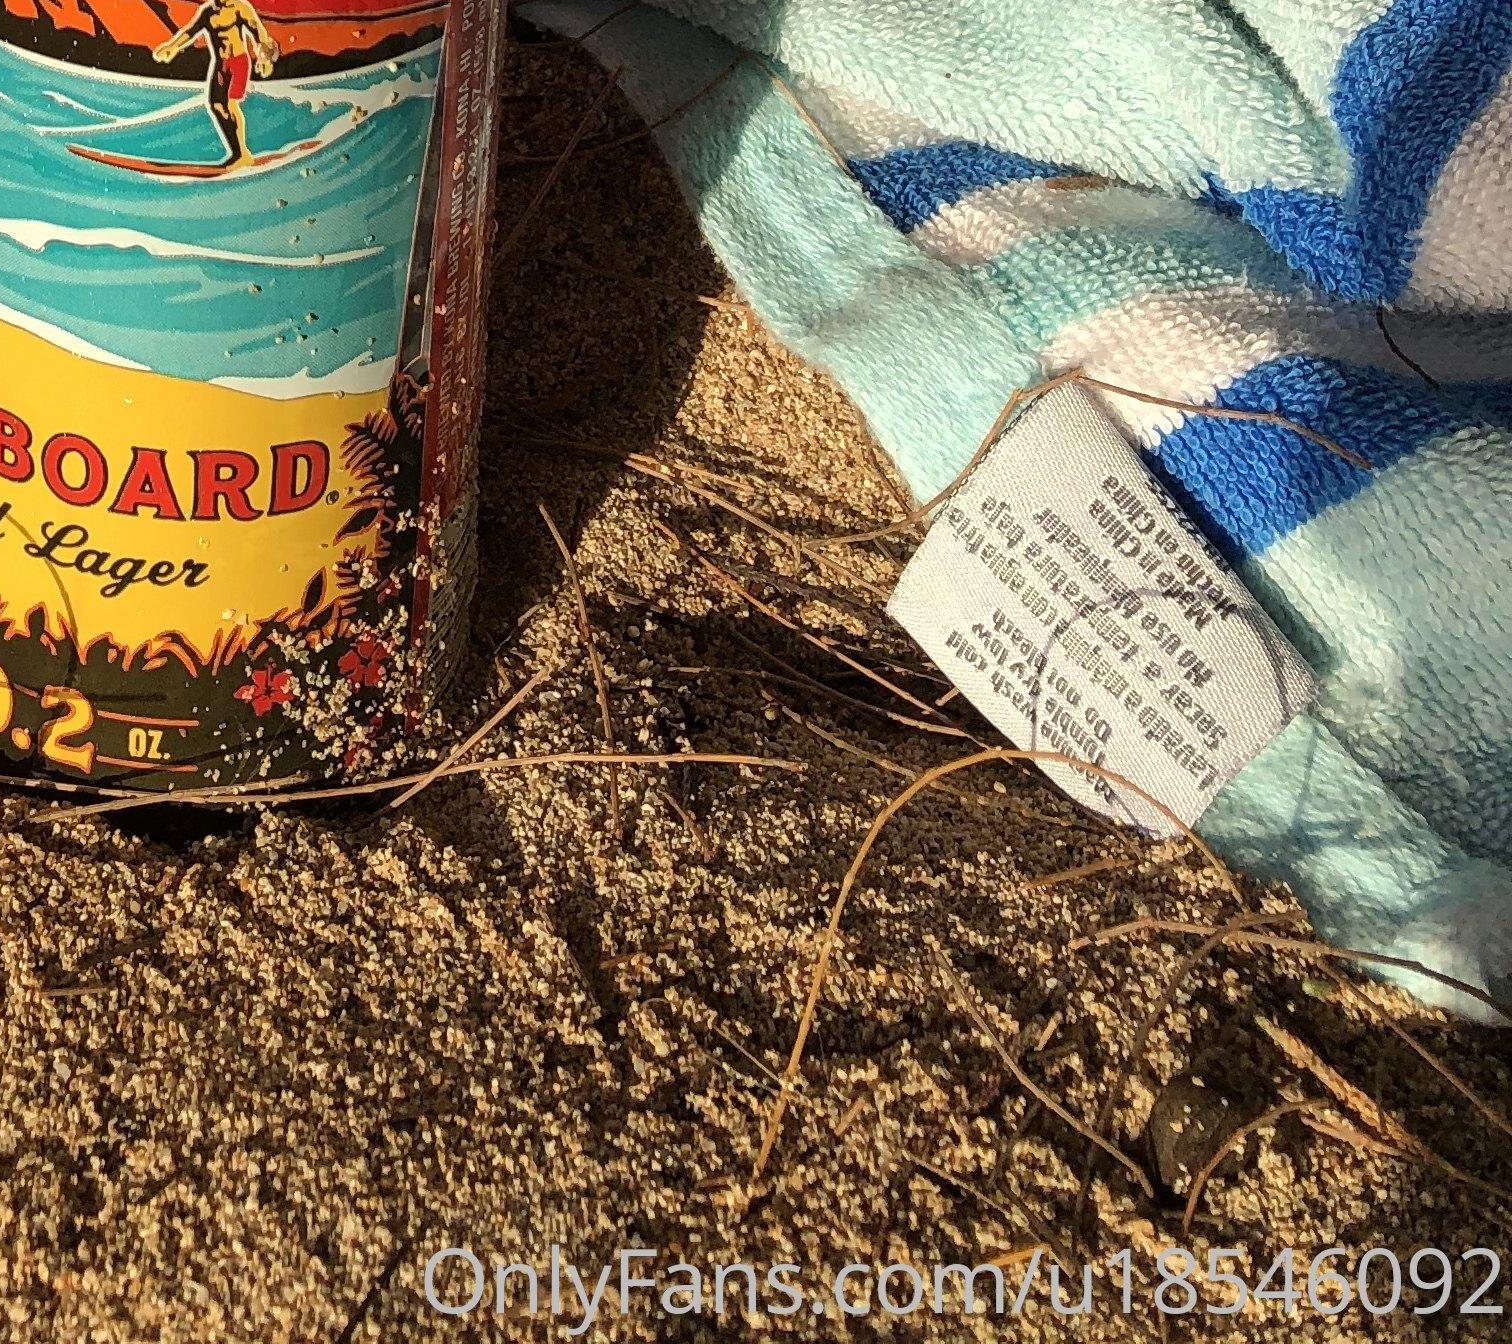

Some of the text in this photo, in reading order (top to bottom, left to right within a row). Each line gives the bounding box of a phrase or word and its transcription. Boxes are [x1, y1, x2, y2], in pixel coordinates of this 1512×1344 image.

[448, 183, 464, 278] BREWING
[459, 48, 472, 72] HI
[1089, 499, 1141, 558] China
[1102, 476, 1155, 534] China
[23, 520, 210, 598] Lager
[981, 544, 1025, 593] agua
[1033, 508, 1143, 619] blanqueador
[1138, 552, 1161, 578] in
[1154, 529, 1179, 554] en
[1021, 587, 1057, 626] con
[1157, 572, 1212, 632] Made
[1176, 554, 1239, 621] Hecho
[981, 497, 1227, 750] Secar a temperatura baja
[972, 623, 1105, 770] Tumble dry low
[993, 609, 1112, 743] Do not bleach
[1177, 650, 1214, 688] No
[945, 631, 1119, 803] Maine wash cold
[1124, 690, 1142, 712] a
[128, 727, 171, 760] OZ.
[1138, 707, 1219, 791] Lavado
